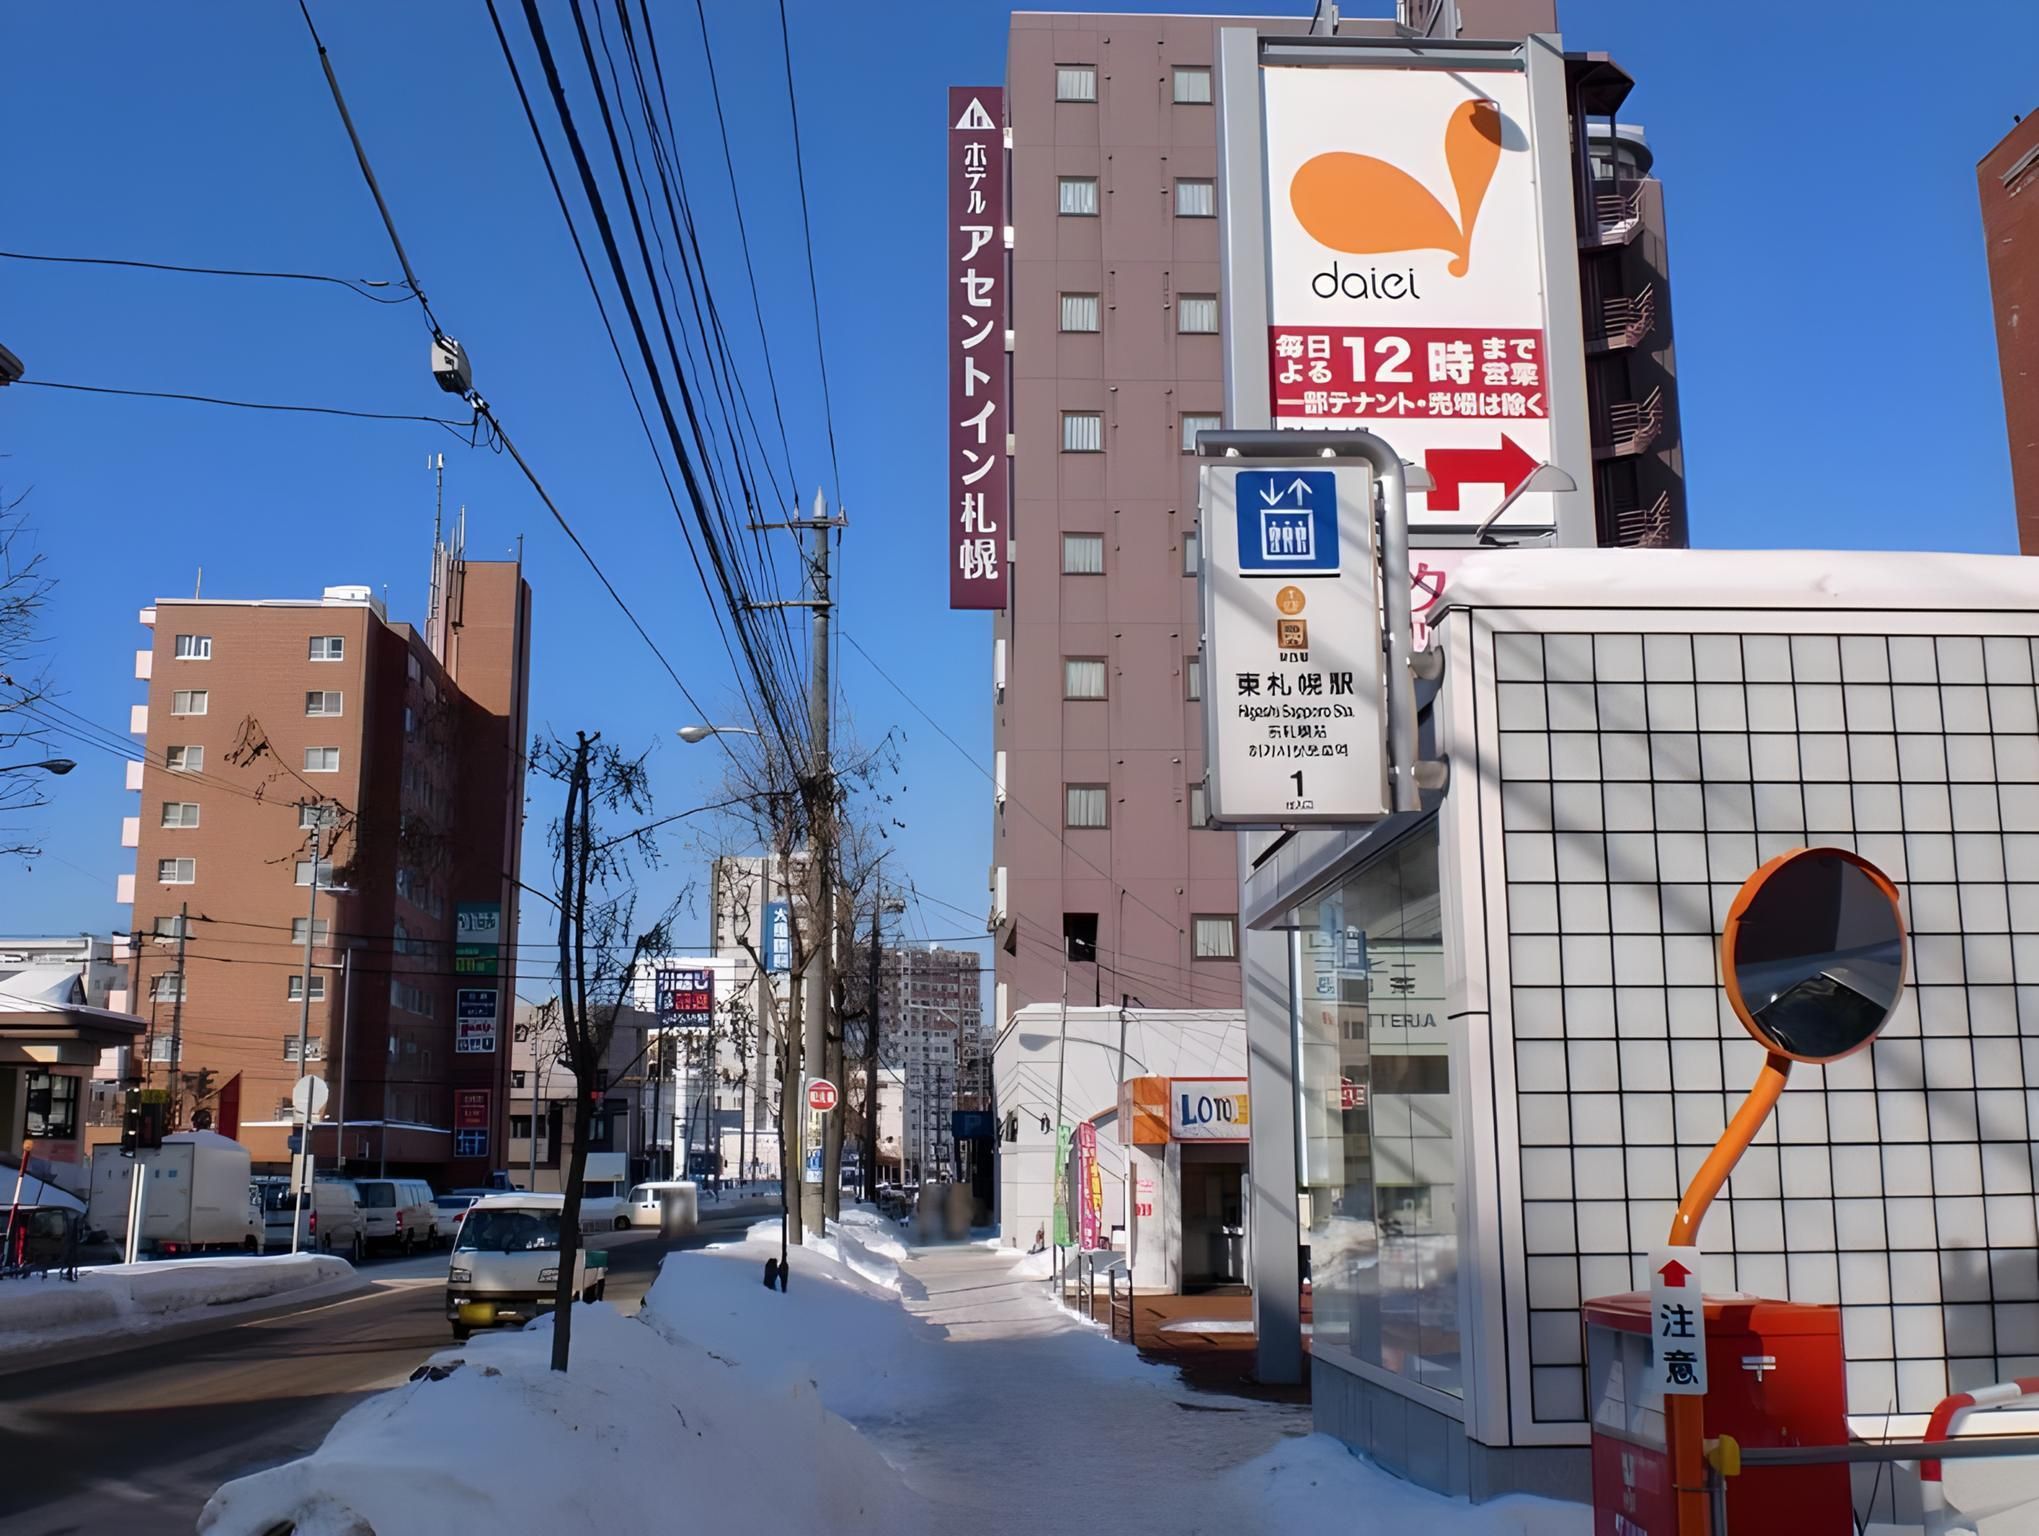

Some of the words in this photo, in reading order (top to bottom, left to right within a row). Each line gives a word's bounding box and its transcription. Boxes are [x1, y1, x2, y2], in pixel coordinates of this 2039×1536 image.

[964, 142, 987, 214] ホテル
[1312, 260, 1420, 299] daiei
[1276, 335, 1331, 358] 毎日
[1482, 337, 1536, 359] まで
[1279, 361, 1332, 383] よる
[1236, 672, 1354, 696] 東札幌駅
[1290, 770, 1303, 797] 1
[1660, 1303, 1699, 1385] 注意
